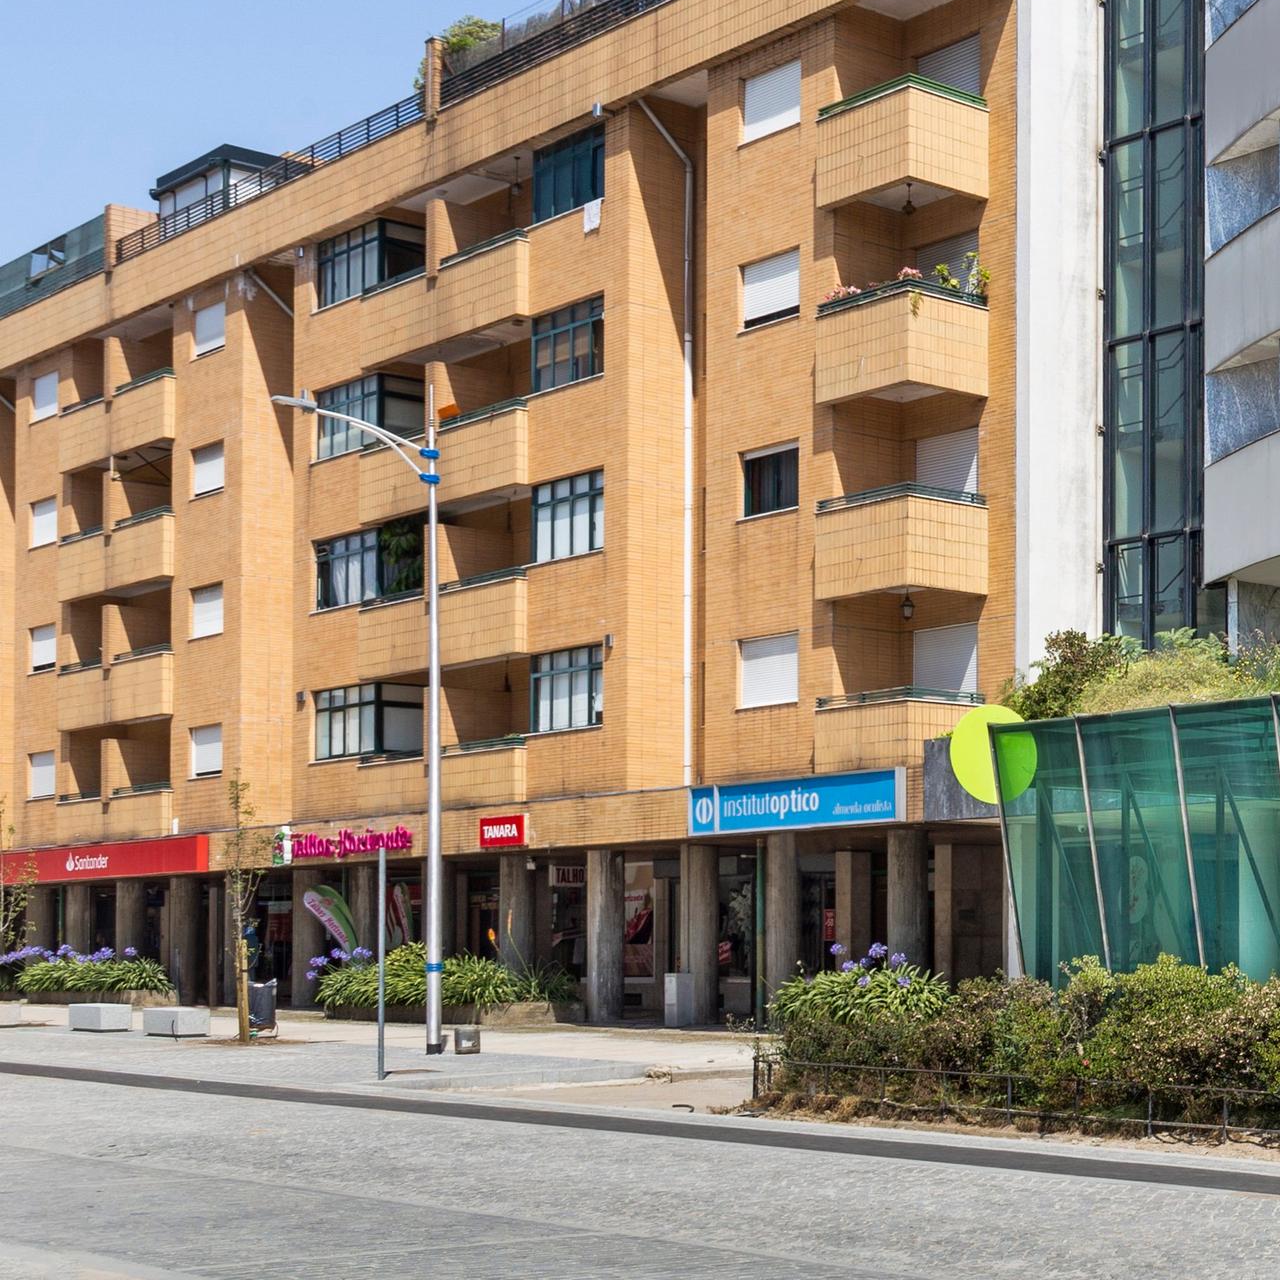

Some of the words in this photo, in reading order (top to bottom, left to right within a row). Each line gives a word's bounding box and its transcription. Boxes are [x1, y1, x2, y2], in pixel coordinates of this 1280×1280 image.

[482, 823, 518, 839] TANARA
[74, 854, 109, 870] Santander
[556, 868, 585, 884] TALHO
